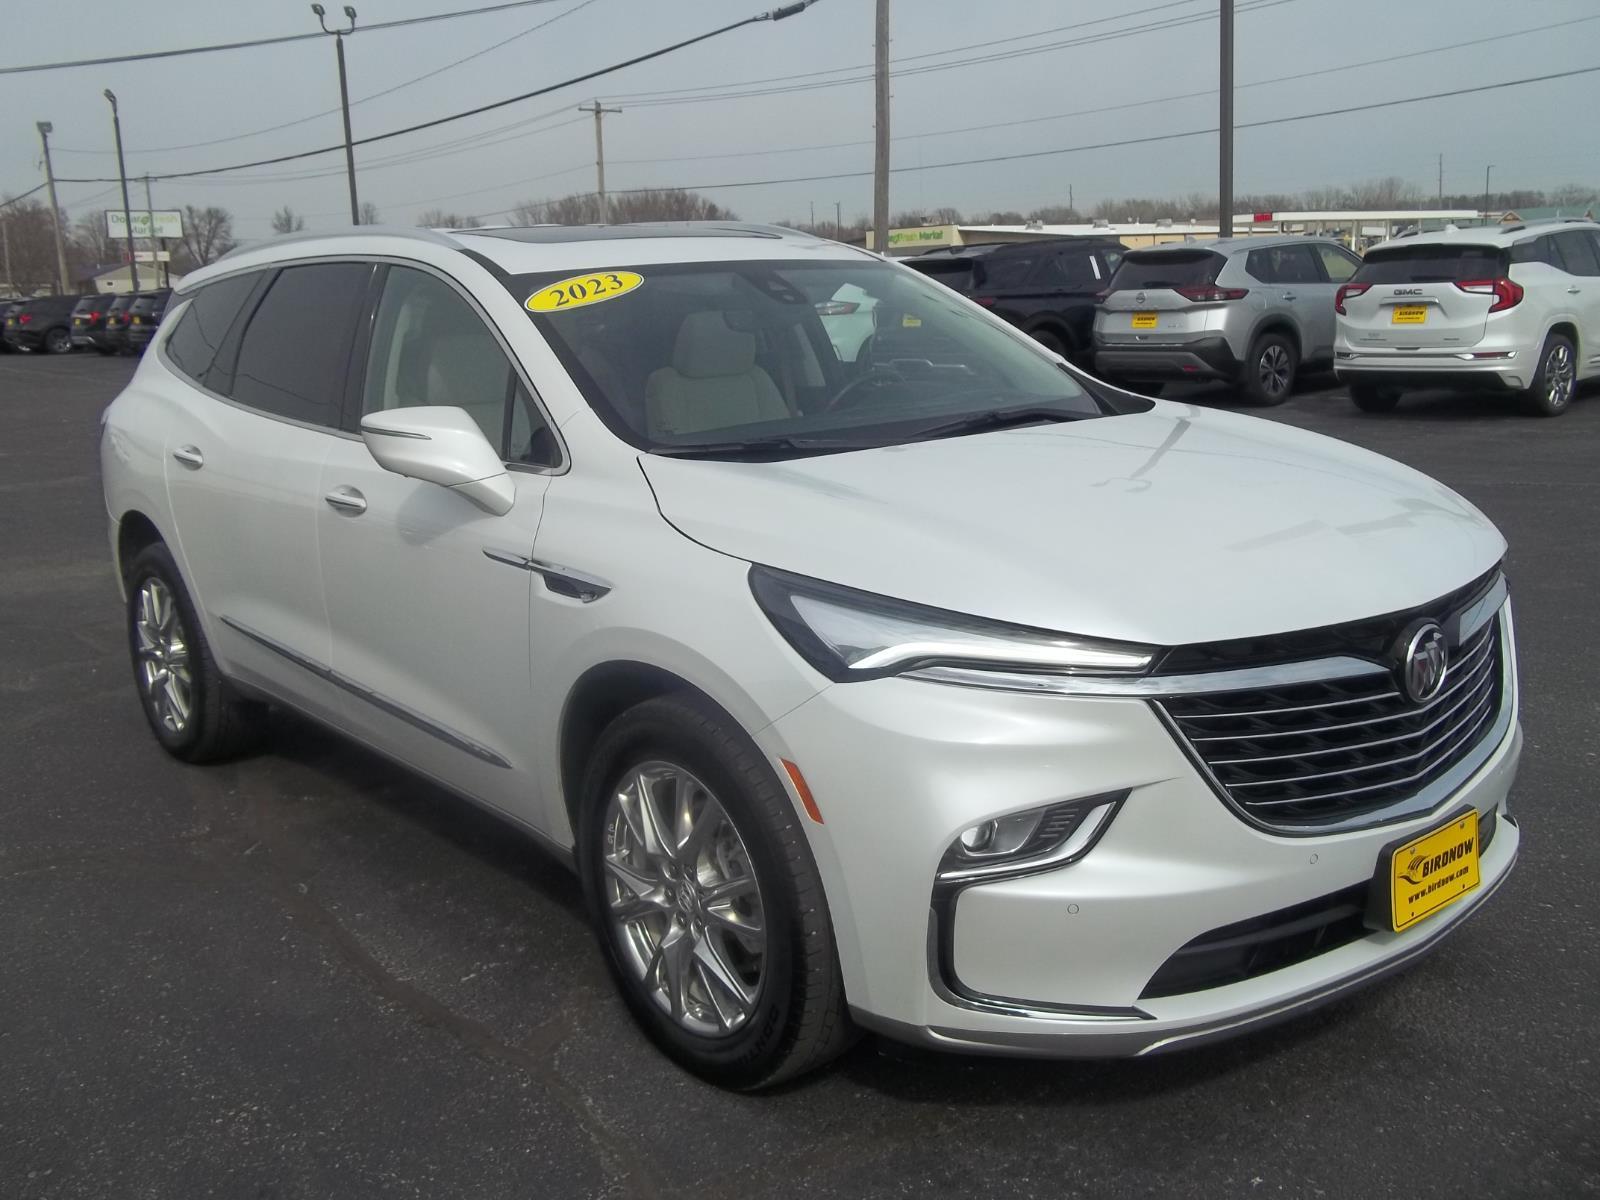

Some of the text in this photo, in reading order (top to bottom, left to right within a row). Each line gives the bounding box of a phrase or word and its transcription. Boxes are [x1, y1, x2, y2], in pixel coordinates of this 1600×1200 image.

[549, 274, 623, 307] 2023
[1393, 288, 1423, 296] GMC
[1422, 837, 1474, 878] BIRDNOW
